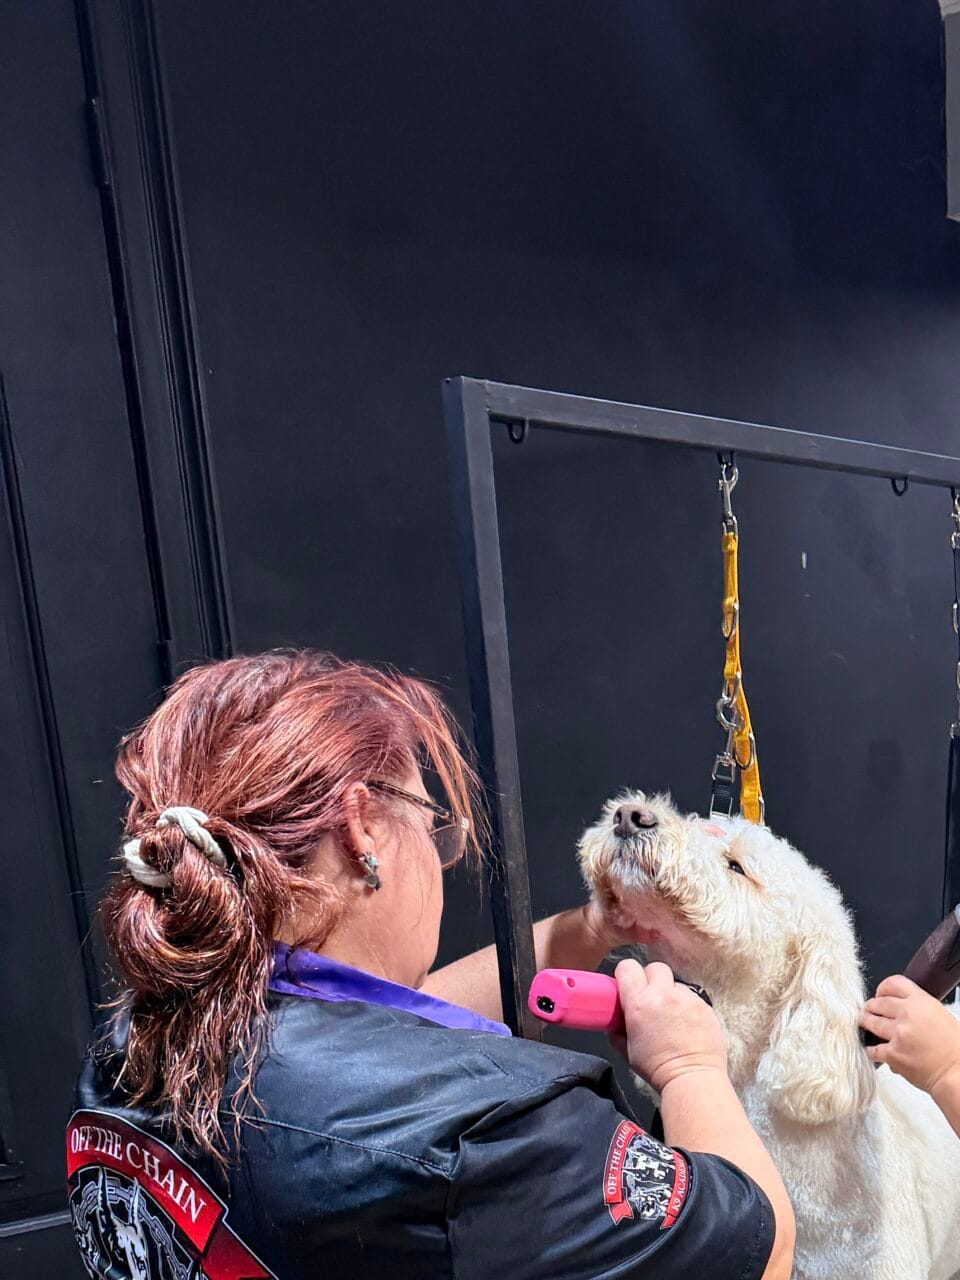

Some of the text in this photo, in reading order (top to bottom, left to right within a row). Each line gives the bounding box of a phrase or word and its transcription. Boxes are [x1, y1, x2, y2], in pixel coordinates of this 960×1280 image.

[71, 1125, 207, 1223] OFF THE CHAIN
